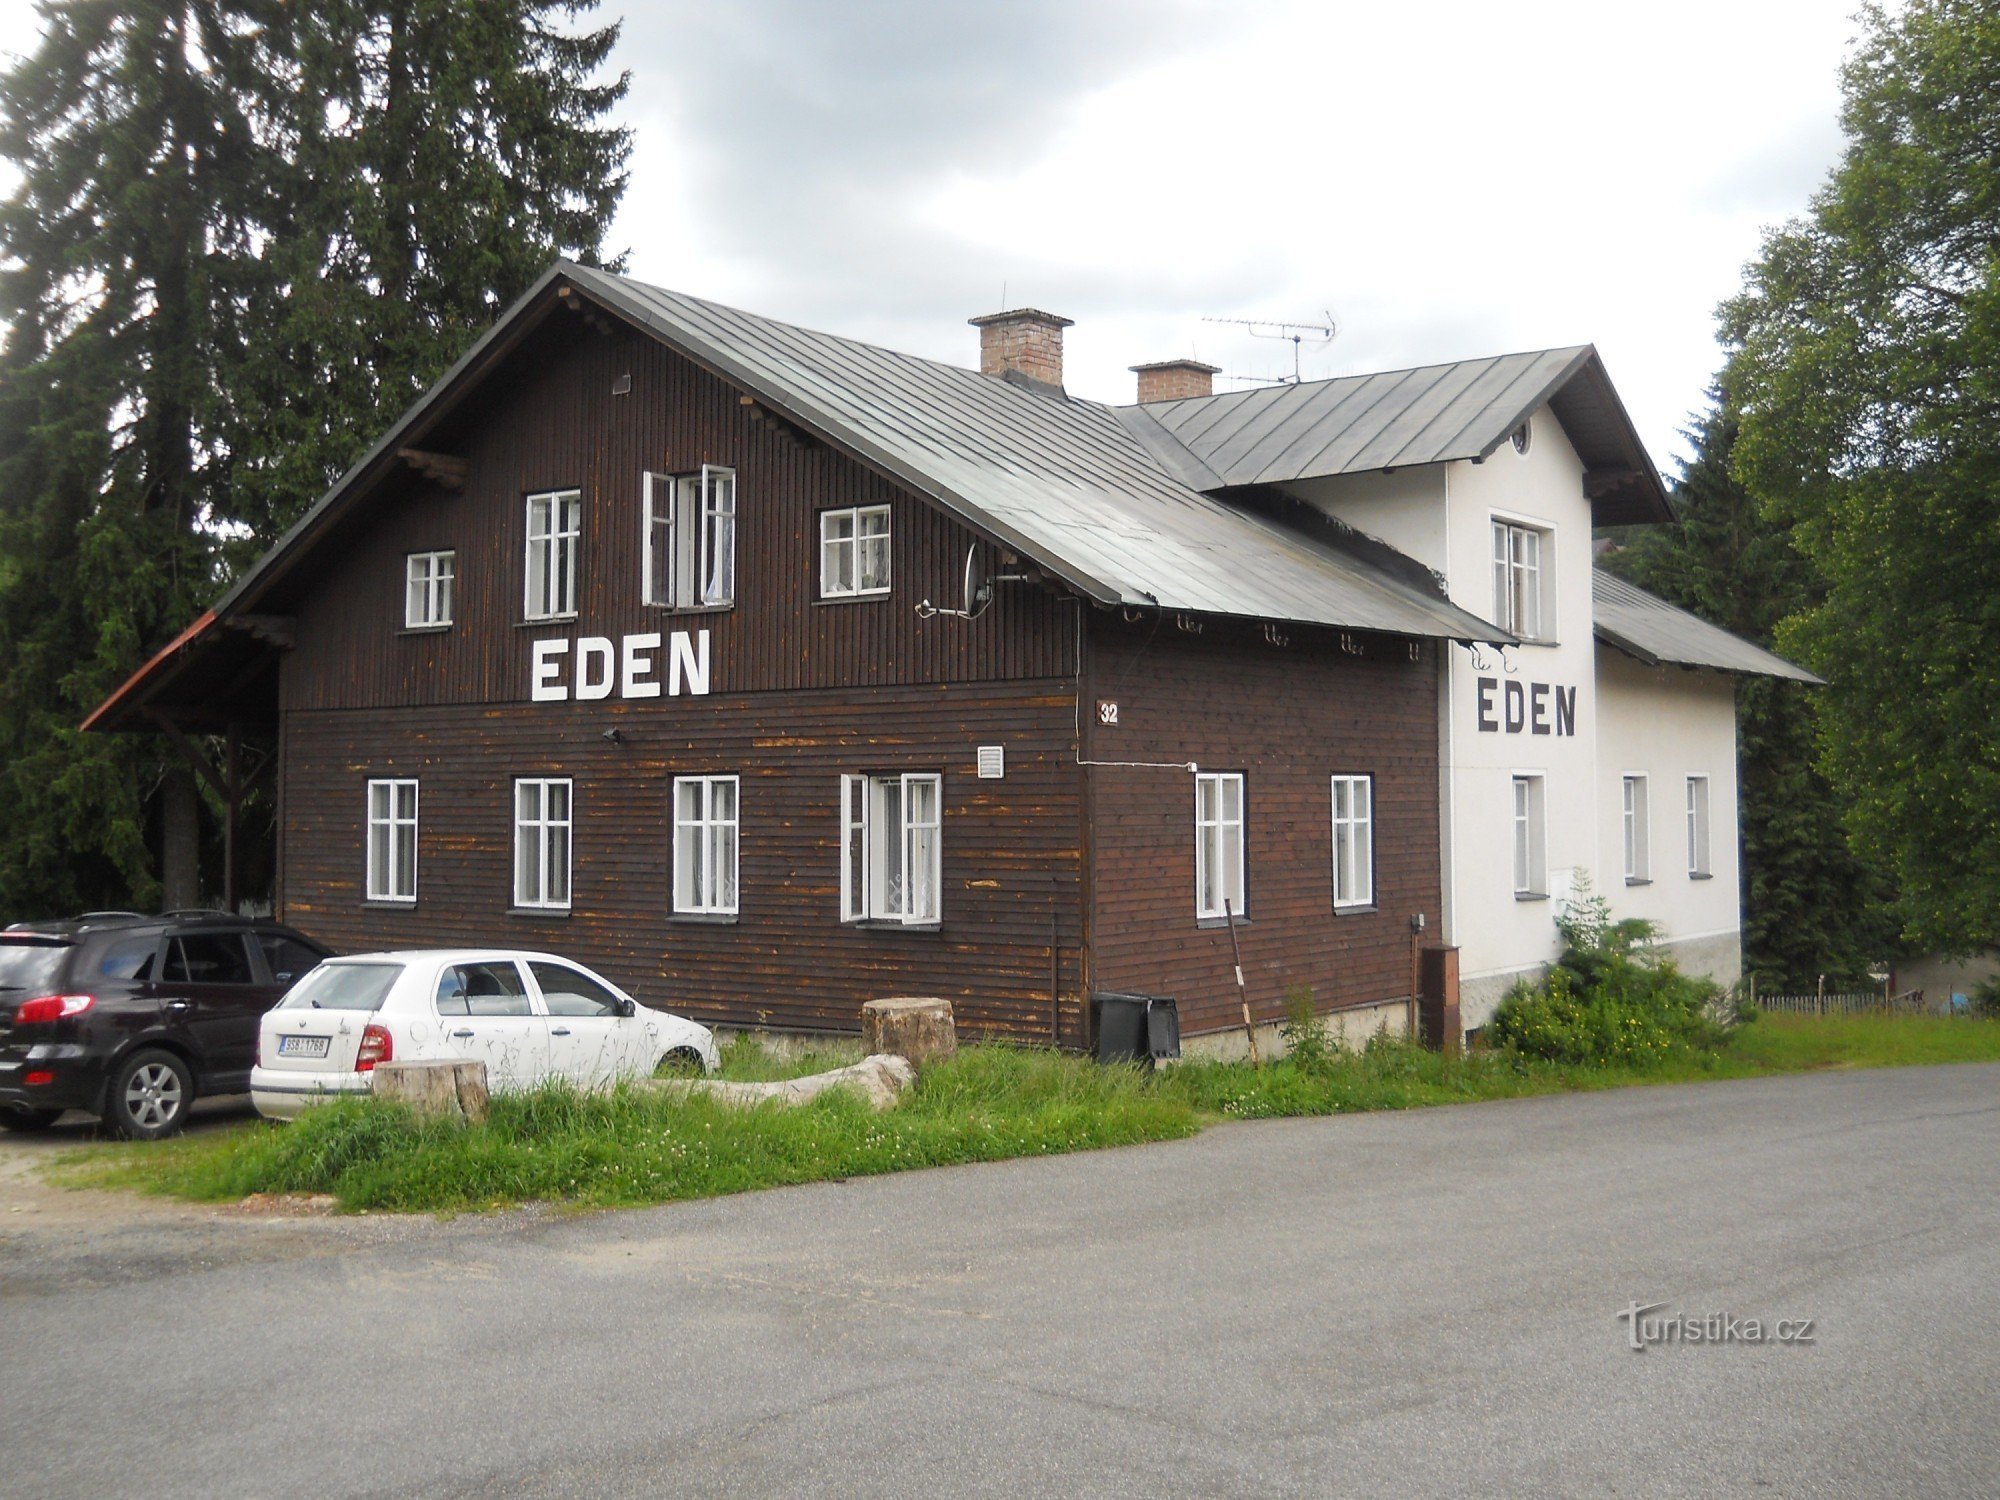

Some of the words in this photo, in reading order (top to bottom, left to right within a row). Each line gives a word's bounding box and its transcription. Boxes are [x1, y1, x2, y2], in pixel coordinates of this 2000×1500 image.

[532, 629, 710, 702] EDEN
[1101, 703, 1118, 723] 32
[1477, 677, 1577, 737] EDEN
